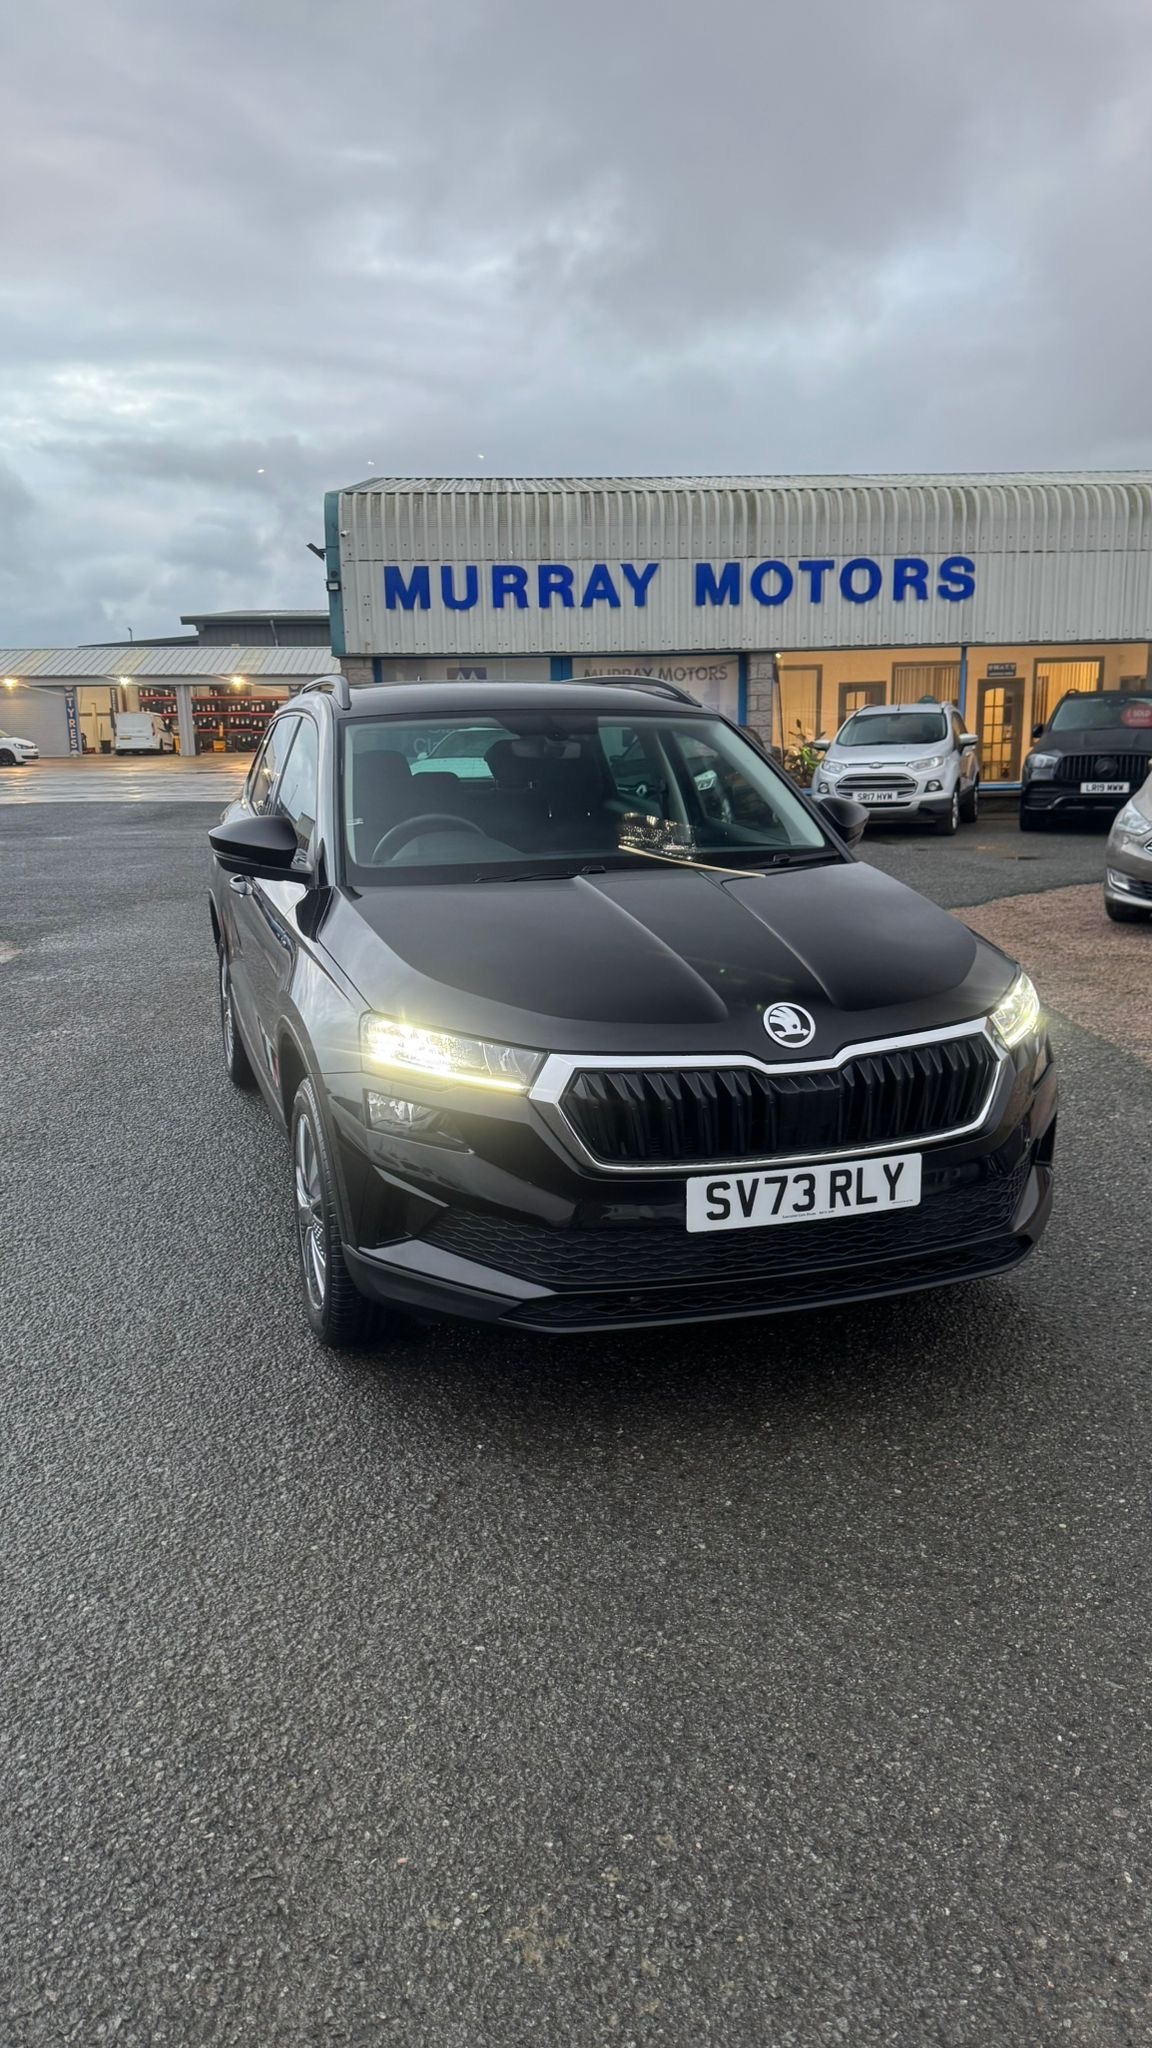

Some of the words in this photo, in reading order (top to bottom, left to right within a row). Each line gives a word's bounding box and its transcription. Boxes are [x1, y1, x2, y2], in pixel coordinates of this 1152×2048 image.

[383, 563, 659, 610] MURRAY
[695, 556, 976, 606] MOTORS
[658, 666, 729, 682] MOTORS
[66, 698, 78, 749] TYRES
[857, 792, 875, 801] SR17
[706, 1173, 816, 1221] SV73
[830, 1162, 904, 1209] RLY
